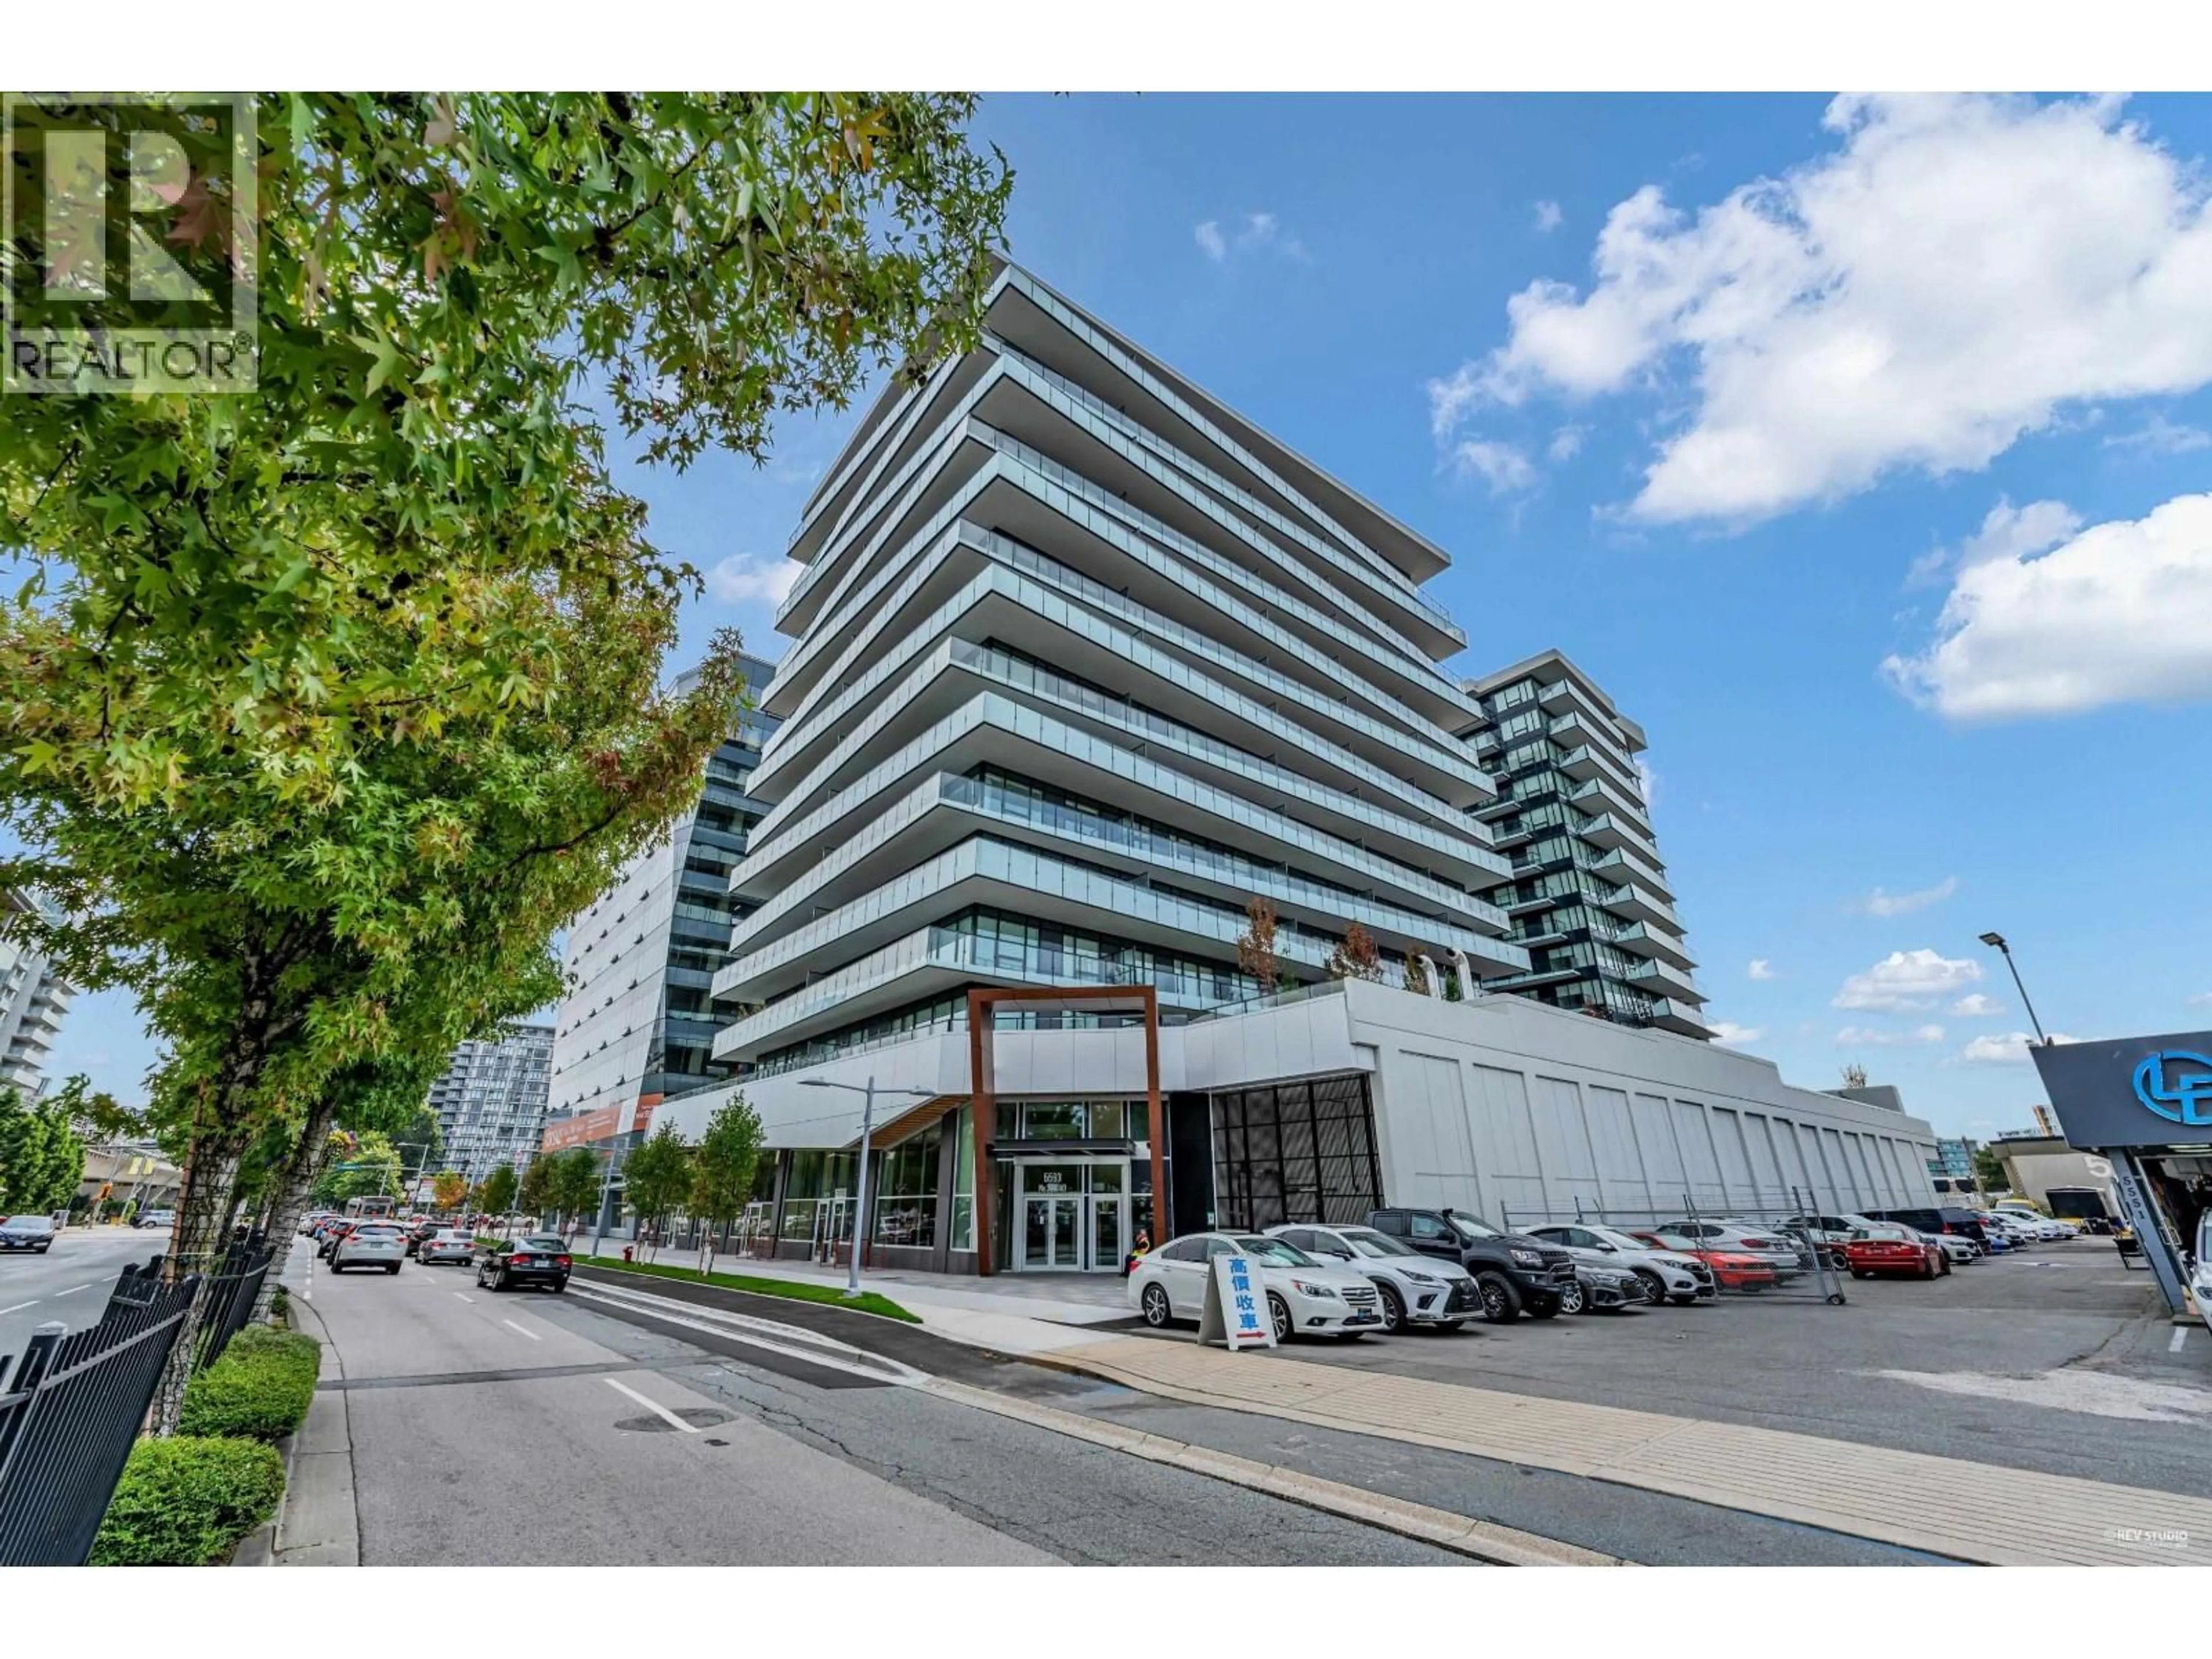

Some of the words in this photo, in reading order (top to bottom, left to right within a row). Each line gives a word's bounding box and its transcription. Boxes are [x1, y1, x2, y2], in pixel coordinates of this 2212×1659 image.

[2123, 1176, 2146, 1219] 5551
[1228, 1258, 1259, 1330] 高價收車
